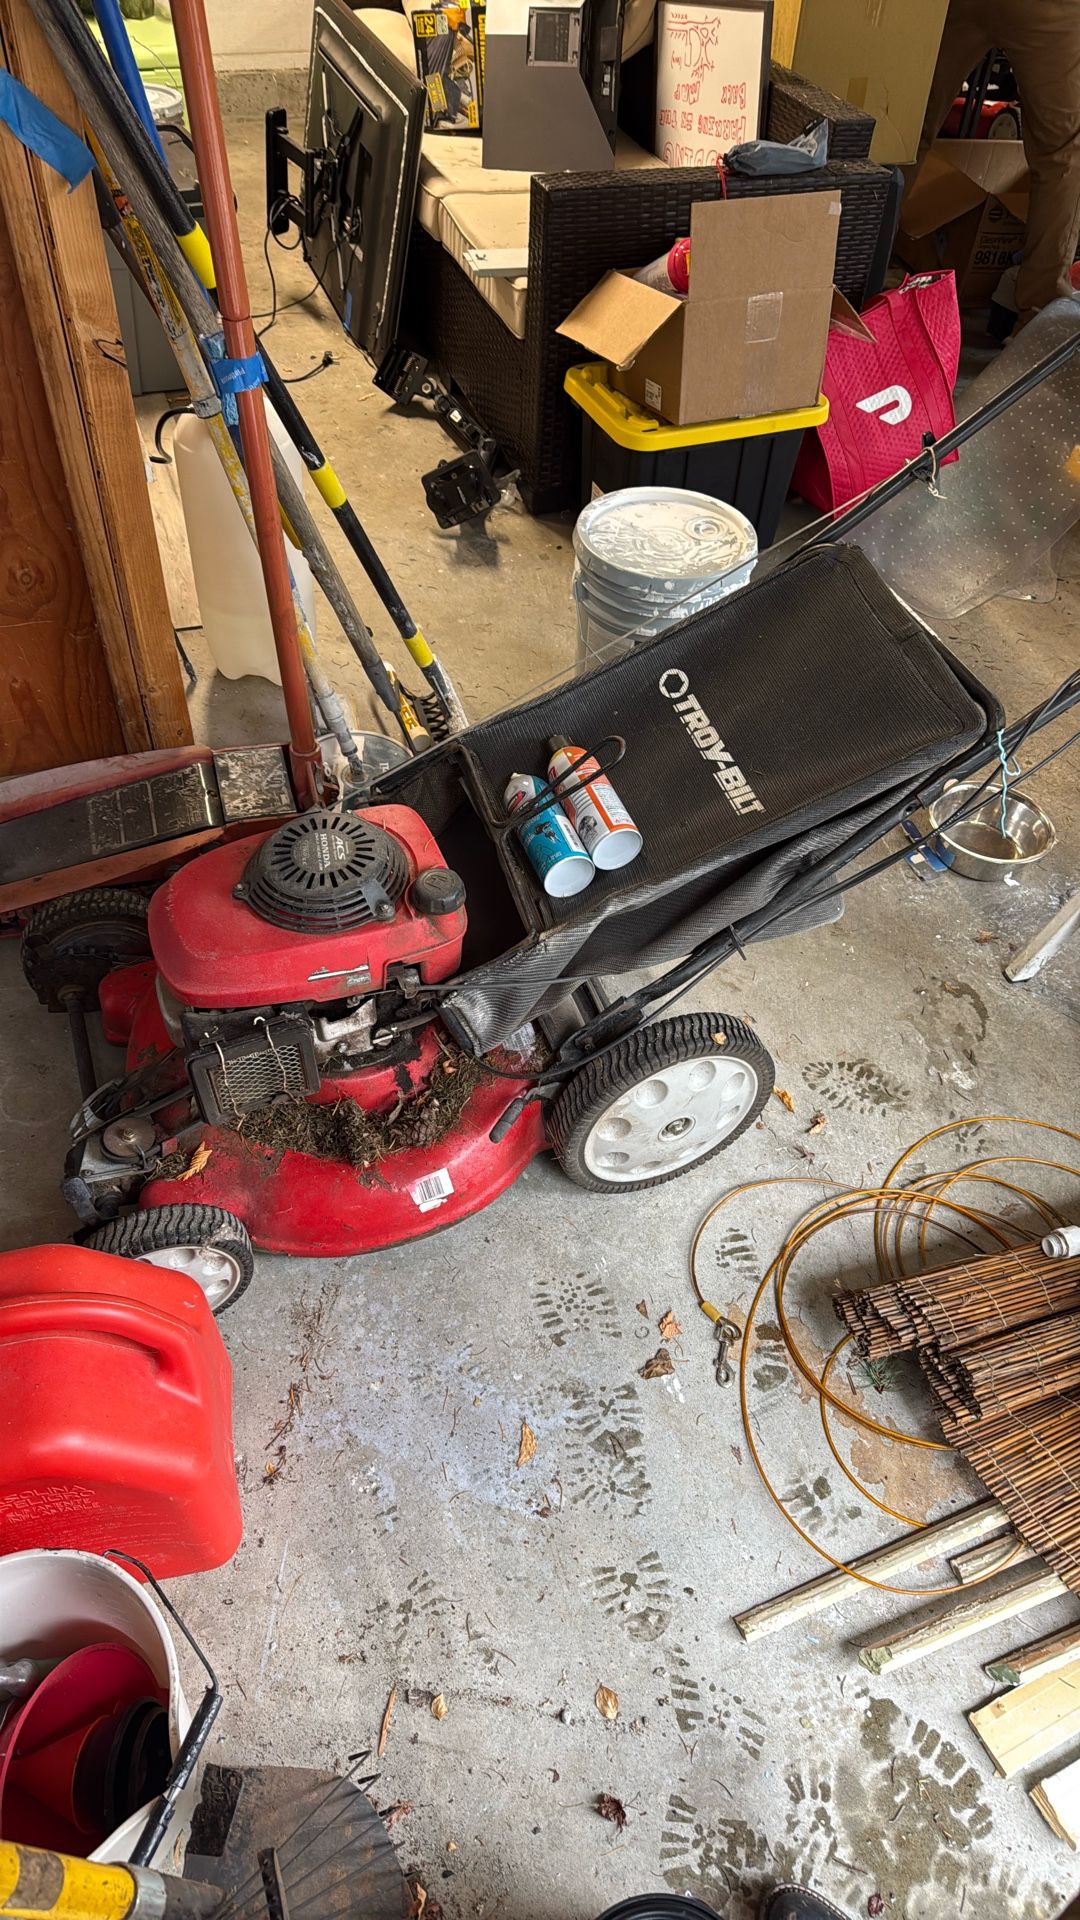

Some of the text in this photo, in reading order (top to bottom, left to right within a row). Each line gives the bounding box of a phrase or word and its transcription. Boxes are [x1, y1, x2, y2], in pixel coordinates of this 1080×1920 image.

[424, 15, 435, 35] 24
[673, 80, 746, 110] BACK MAP
[660, 109, 746, 146] PARKING IN THE
[672, 692, 767, 816] TROY-BILT
[319, 833, 331, 868] HONDA
[334, 835, 346, 860] ACS
[0, 1485, 87, 1504] SOLINA
